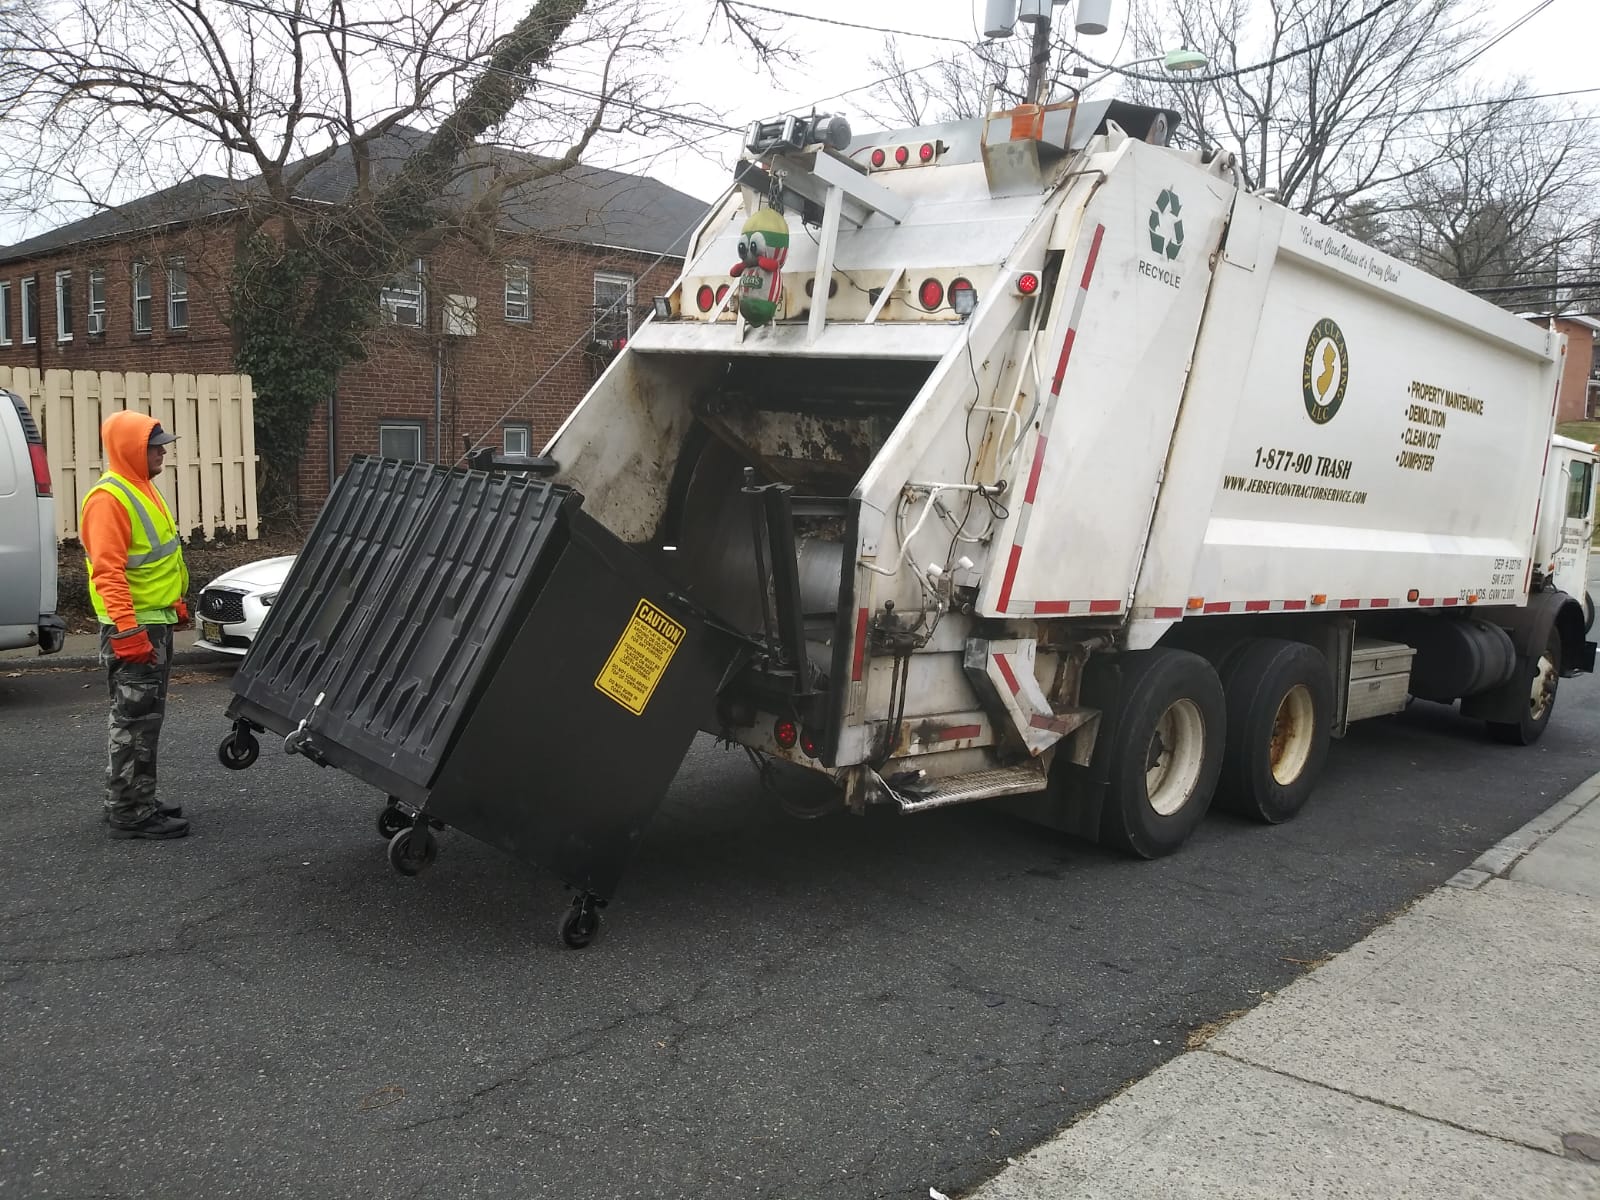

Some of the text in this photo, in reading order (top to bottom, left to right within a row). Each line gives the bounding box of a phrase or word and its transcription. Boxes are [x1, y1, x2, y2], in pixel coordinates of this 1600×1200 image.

[1138, 260, 1181, 289] RECYCLE
[1303, 320, 1348, 401] JERSEY CLEANING
[1311, 403, 1330, 420] LLC
[1410, 380, 1484, 416] PROPERTY MAINTENANCE
[1408, 403, 1446, 429] DEMOLITION
[1404, 427, 1441, 450] CLEAN OUT
[1254, 446, 1353, 481] 1-877-90 TRASH
[1399, 450, 1435, 473] DUMPSTER
[1222, 474, 1368, 505] WWW.JERSEYCONTRACTORSERVICE.COM
[639, 604, 682, 643] CAUTION
